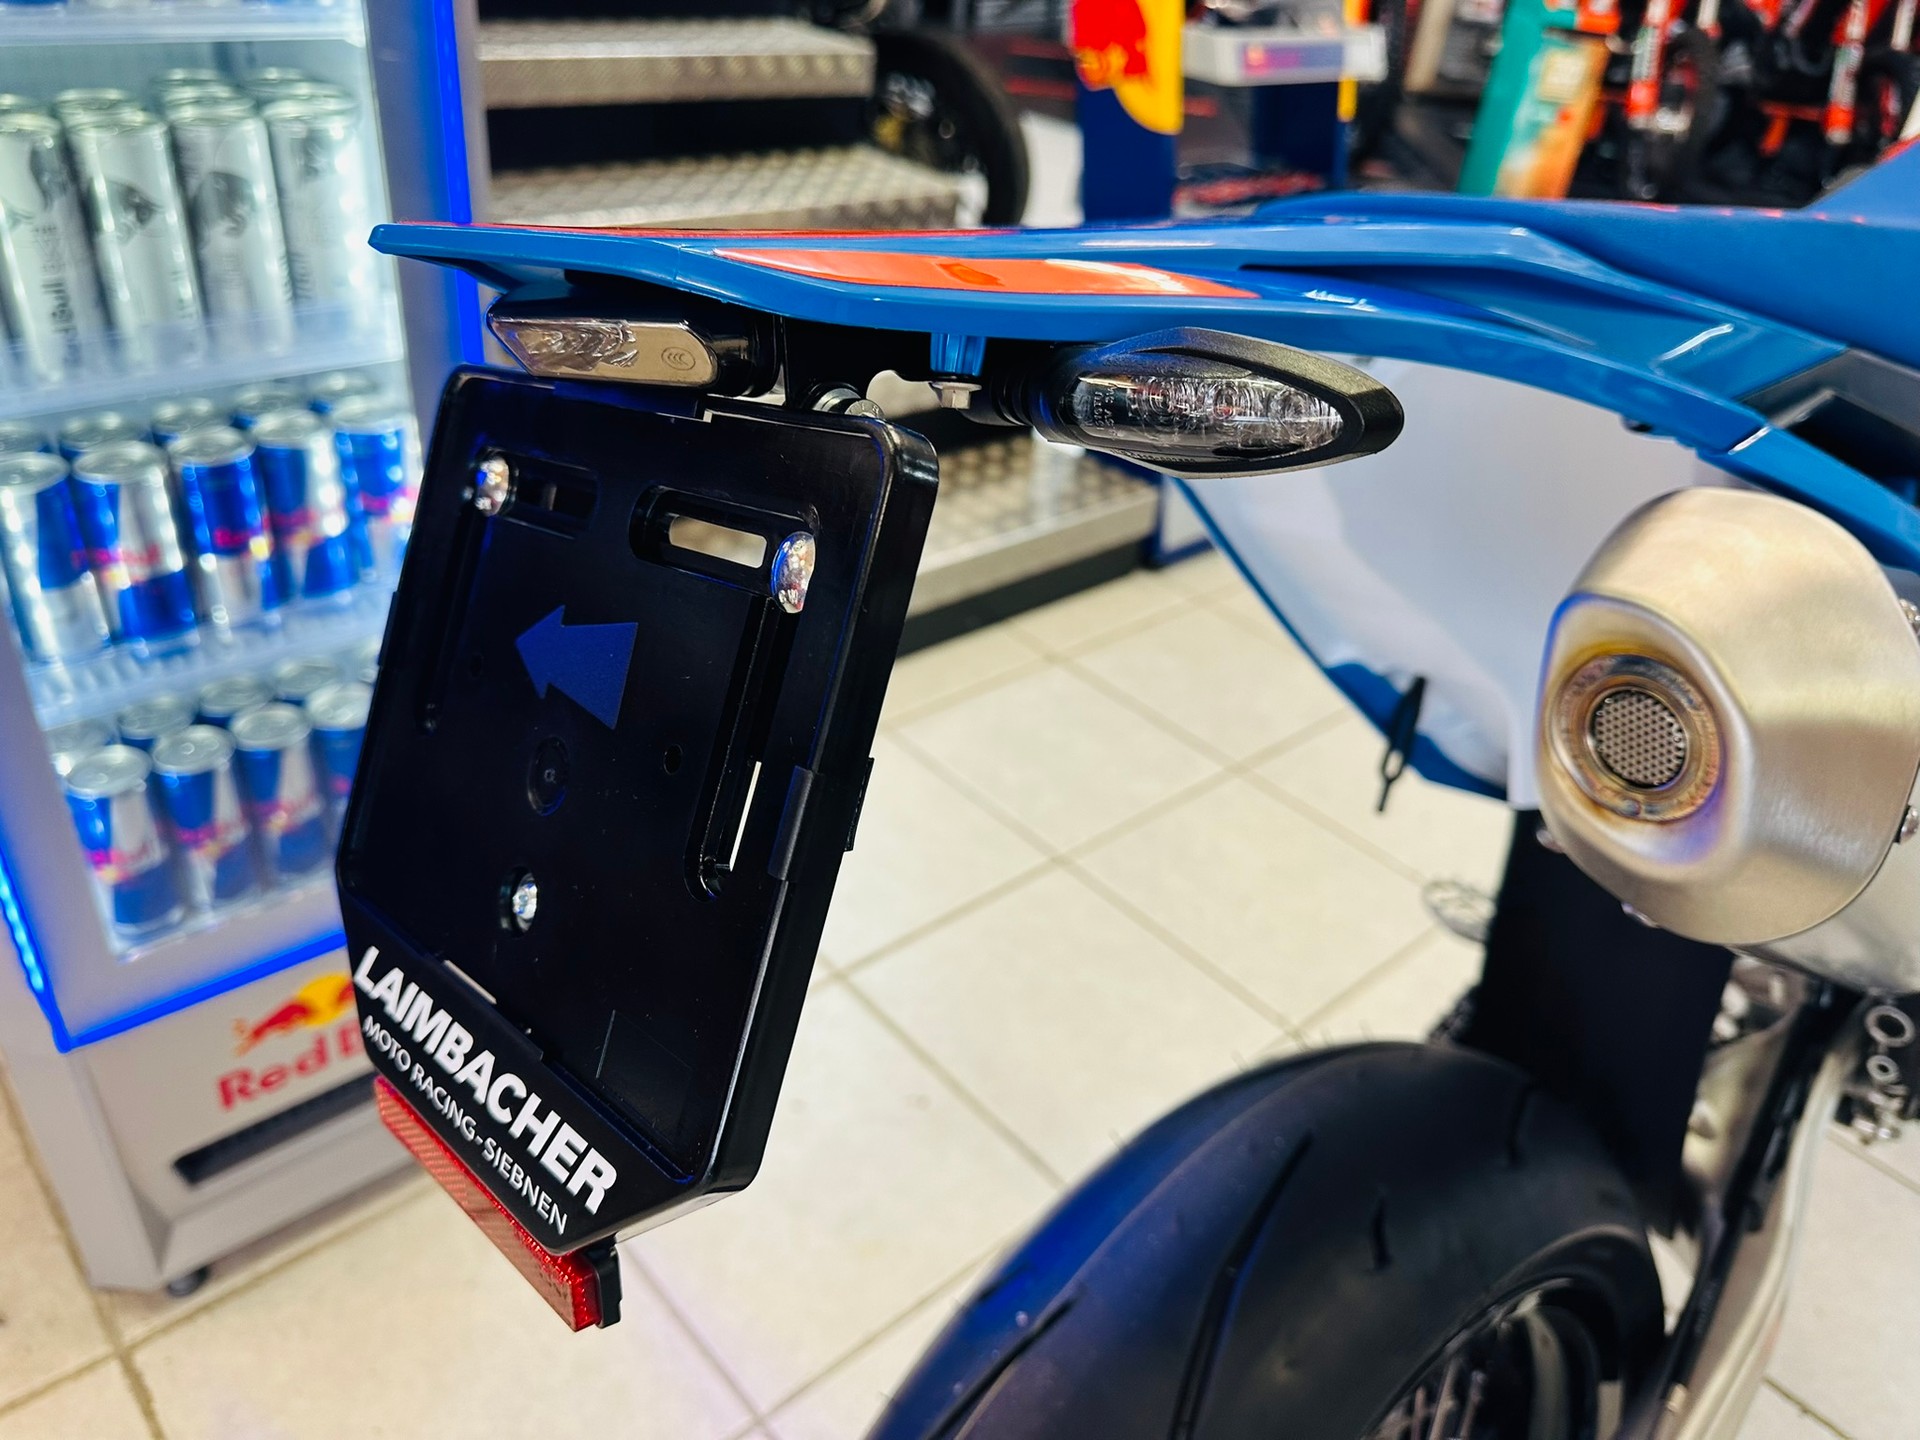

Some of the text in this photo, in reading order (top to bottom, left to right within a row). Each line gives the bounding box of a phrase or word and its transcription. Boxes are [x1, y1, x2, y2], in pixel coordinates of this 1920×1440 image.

[218, 1033, 329, 1110] Red
[353, 945, 617, 1215] LAIMBACHER
[361, 1014, 569, 1236] MOTO RACING-SIEBNEN
